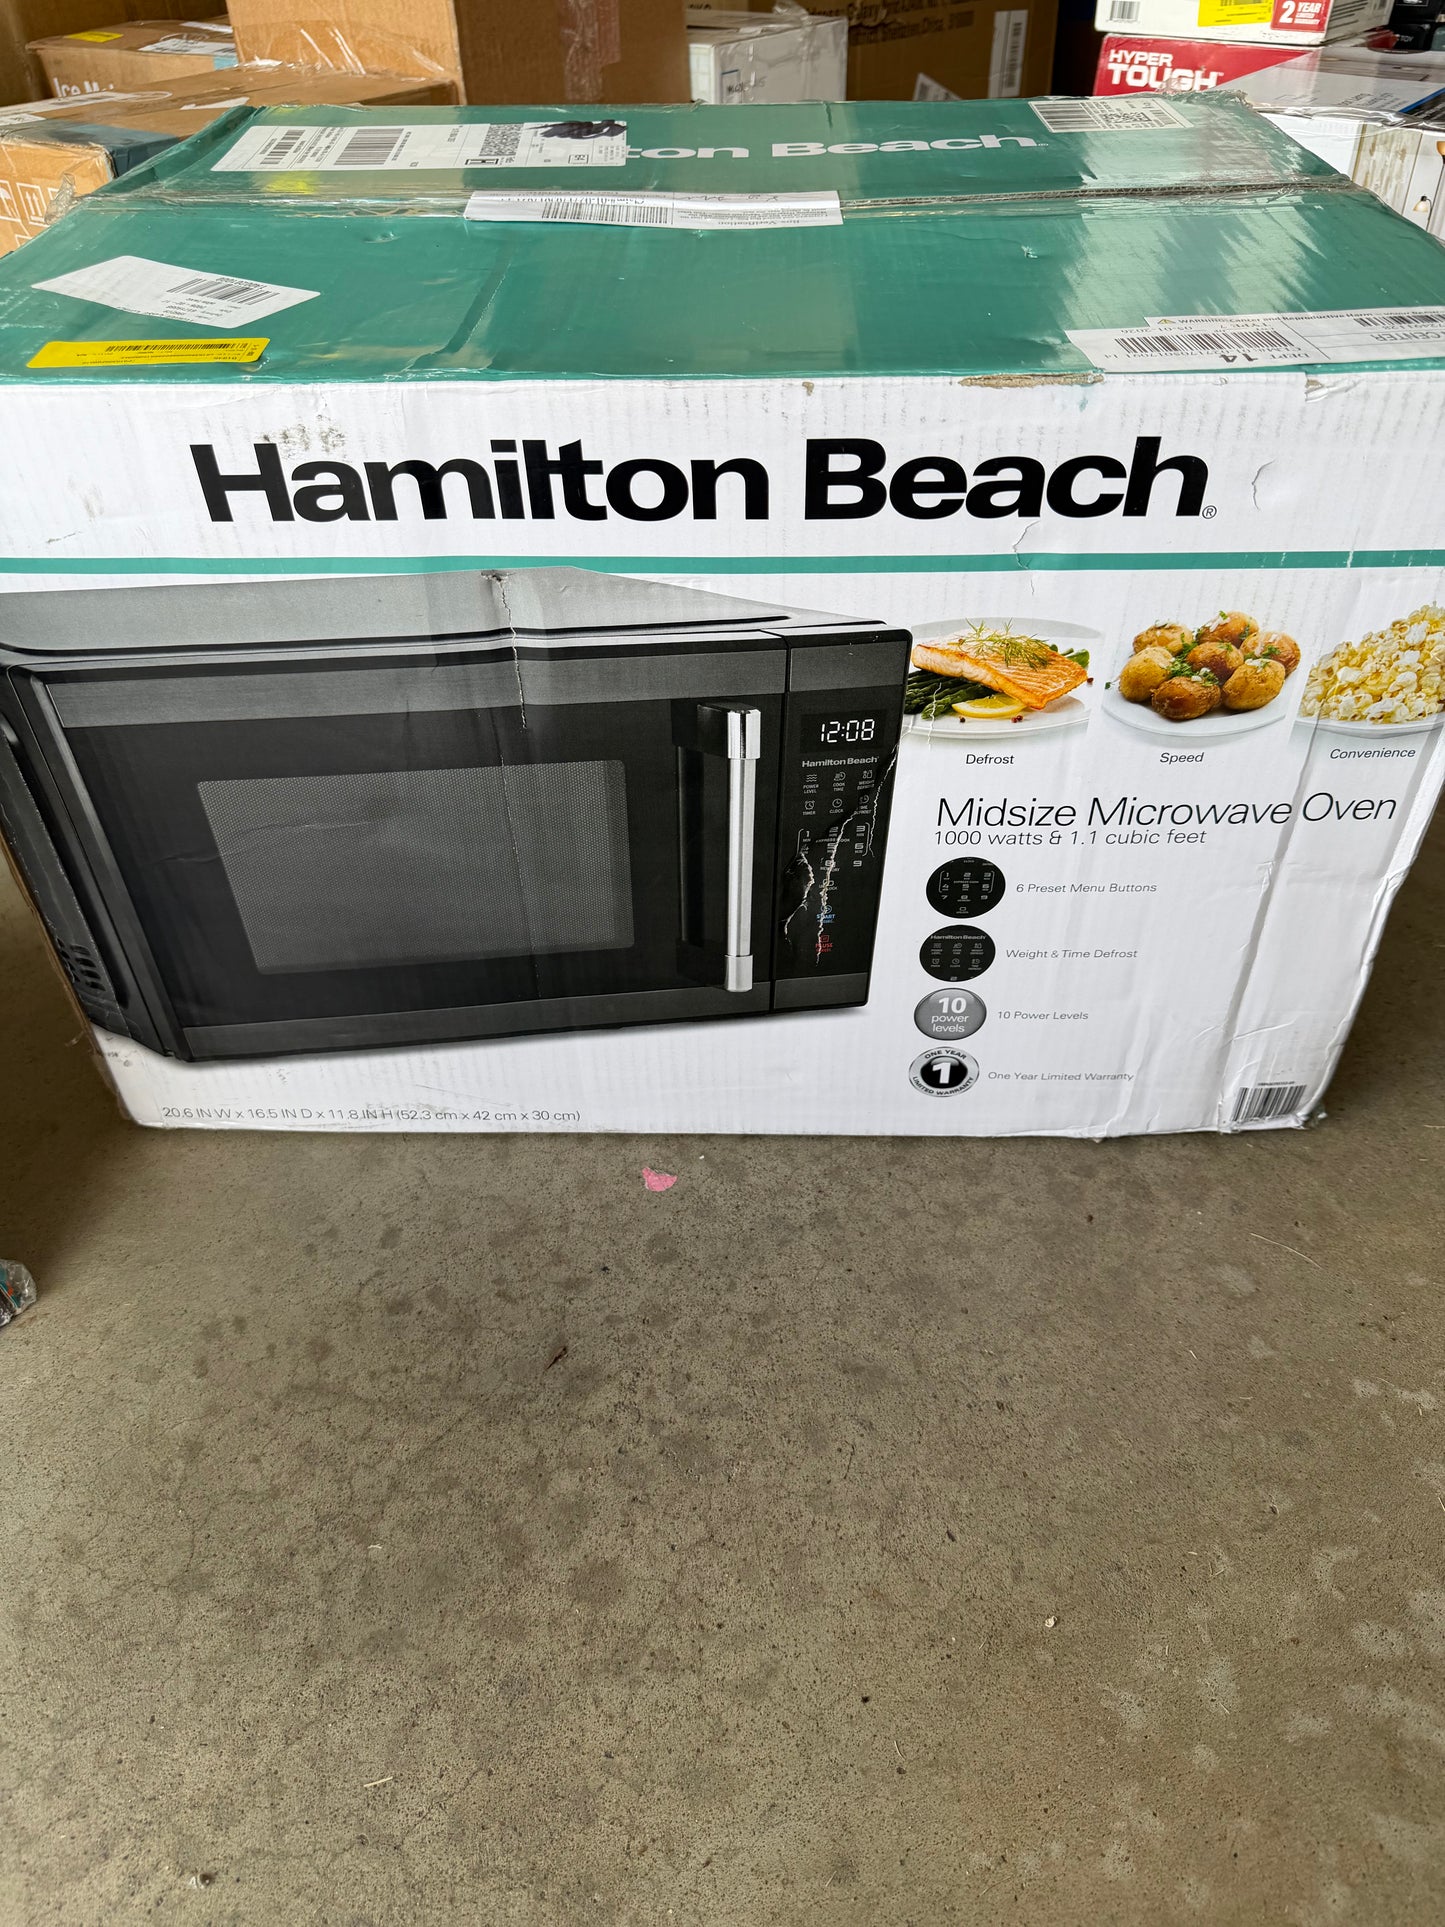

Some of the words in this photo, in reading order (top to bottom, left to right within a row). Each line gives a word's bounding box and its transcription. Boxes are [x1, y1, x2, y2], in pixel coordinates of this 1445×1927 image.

[1279, 0, 1296, 23] 2
[1298, 2, 1322, 13] YEAR
[1108, 49, 1173, 67] HYPER
[1370, 332, 1441, 342] CENTER
[1219, 354, 1259, 363] 14
[189, 438, 769, 522] Hamilton
[820, 718, 875, 743] 12:08
[1160, 752, 1204, 765] Speed
[1329, 746, 1416, 760] Convenience
[802, 759, 846, 768] Hamilton
[847, 756, 878, 765] Beach
[965, 754, 1014, 765] Defrost
[936, 798, 1077, 828] Midsize
[1087, 796, 1293, 827] Microwave
[1302, 792, 1398, 822] Oven
[806, 830, 810, 838] 1
[934, 830, 982, 846] 1000
[988, 830, 1043, 846] watts
[1049, 830, 1063, 846] &
[1071, 830, 1098, 845] 1.1
[1105, 829, 1161, 845] cubic
[1166, 829, 1207, 845] feet
[854, 842, 864, 850] 6
[1016, 884, 1025, 893] 6
[1027, 883, 1066, 893] Preset
[1070, 883, 1106, 893] Menu
[1109, 883, 1157, 892] Buttons
[1006, 950, 1048, 960] Weight
[1051, 950, 1059, 958] &
[1062, 950, 1090, 958] Time
[1094, 950, 1138, 958] Defrost
[938, 997, 967, 1014] 10
[931, 1014, 969, 1024] power
[998, 1011, 1011, 1020] 10
[1014, 1011, 1050, 1020] Power
[1053, 1011, 1089, 1020] Levels
[932, 1024, 965, 1033] levels
[925, 1050, 942, 1059] ONE
[945, 1050, 966, 1060] YEAR
[932, 1062, 951, 1084] 1
[988, 1072, 1011, 1080] One
[1014, 1072, 1038, 1080] Year
[1041, 1072, 1082, 1080] Limited
[1084, 1072, 1134, 1082] Warranty
[912, 1076, 934, 1094] LIMITED
[936, 1077, 974, 1095] WARRANTY
[162, 1107, 194, 1118] 20.6
[197, 1108, 212, 1118] IN
[214, 1108, 232, 1118] W
[249, 1108, 278, 1119] 16.5
[282, 1108, 297, 1119] IN
[301, 1108, 312, 1118] D
[329, 1109, 359, 1120] 11.8
[362, 1110, 378, 1119] IN
[381, 1110, 394, 1120] H
[397, 1110, 432, 1120] (52.3
[435, 1112, 458, 1120] cm
[462, 1112, 470, 1120] x
[473, 1110, 490, 1120] 42
[532, 1110, 550, 1120] 30
[554, 1110, 581, 1121] cm)
